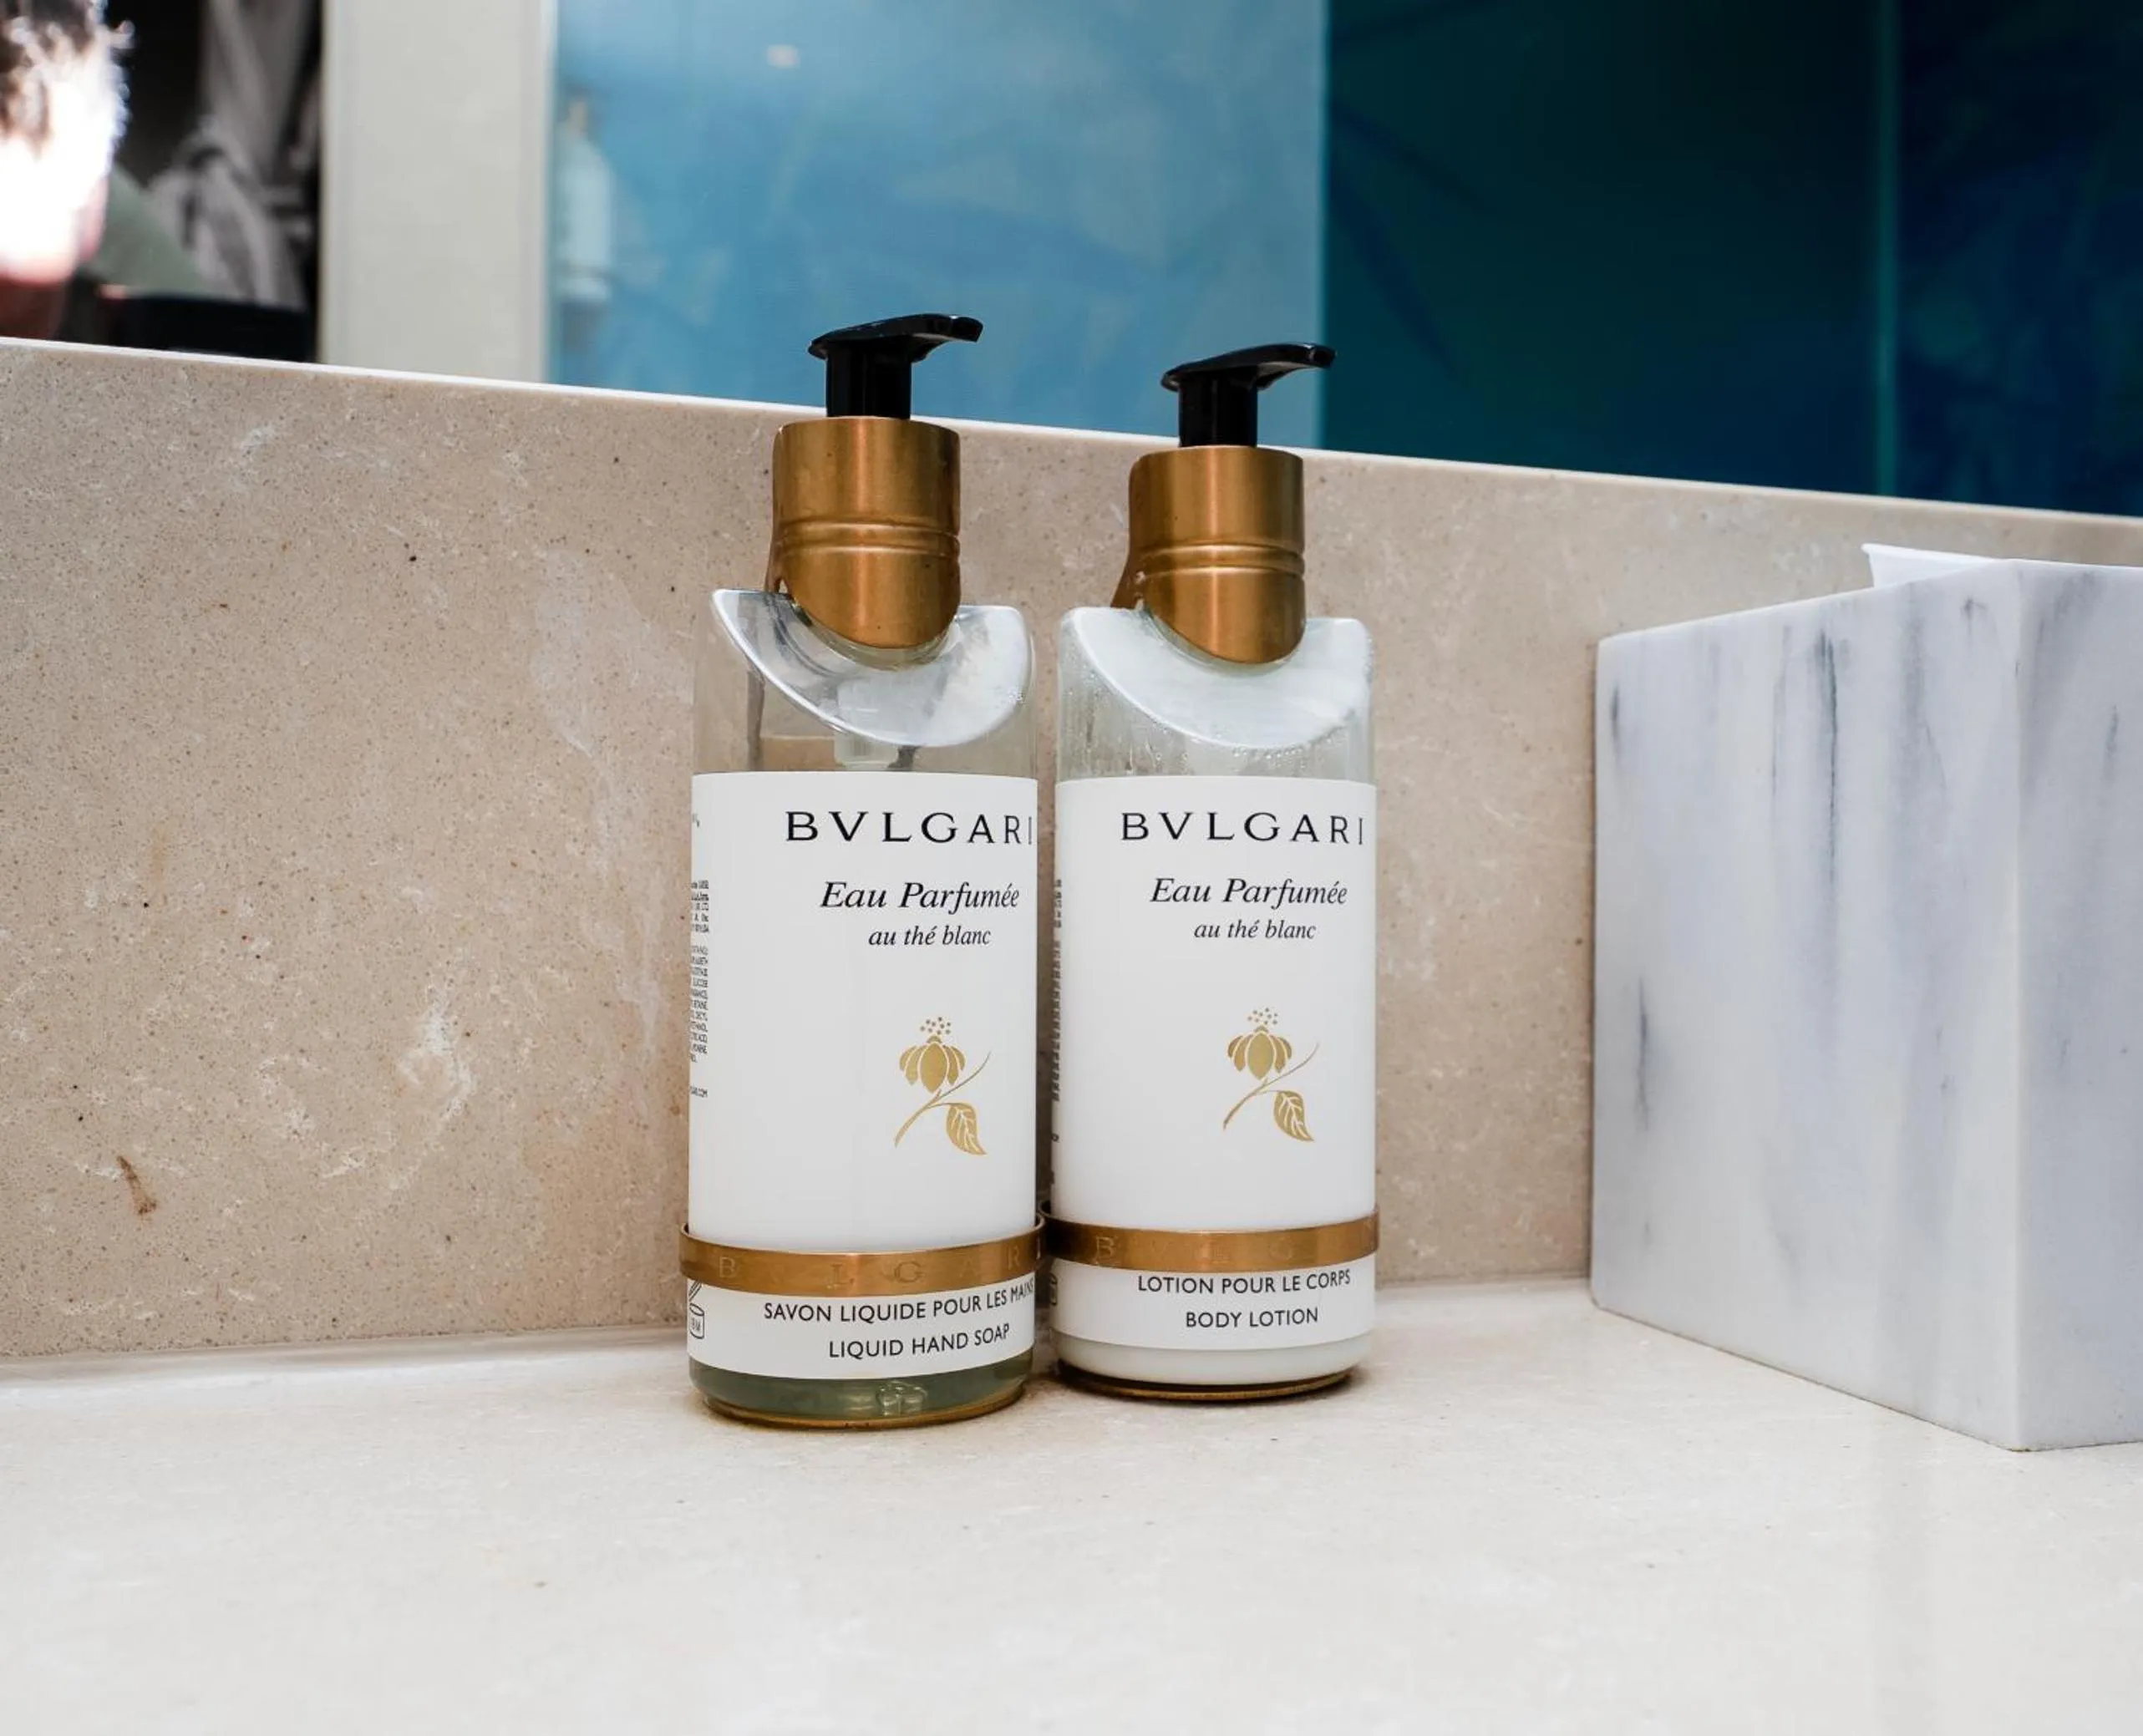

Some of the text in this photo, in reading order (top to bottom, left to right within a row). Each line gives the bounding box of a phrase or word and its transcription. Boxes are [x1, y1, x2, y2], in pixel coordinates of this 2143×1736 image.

[785, 810, 1033, 845] BVLGARI
[1120, 811, 1364, 845] BVLGARI
[820, 881, 887, 908] Eau
[897, 881, 1020, 916] Parfumée
[1149, 877, 1348, 911] Eau Parfumée
[868, 924, 992, 946] au thé blanc
[1193, 918, 1317, 940] au thé blanc
[1138, 1268, 1351, 1295] LOTION POUR LE CORPS
[764, 1302, 832, 1322] SAVON
[840, 1301, 927, 1325] LIQUIDE
[932, 1295, 983, 1317] POUR
[986, 1289, 1008, 1310] LES
[1186, 1307, 1318, 1328] BODY LOTION
[829, 1322, 1010, 1361] LIQUID HAND SOAP
